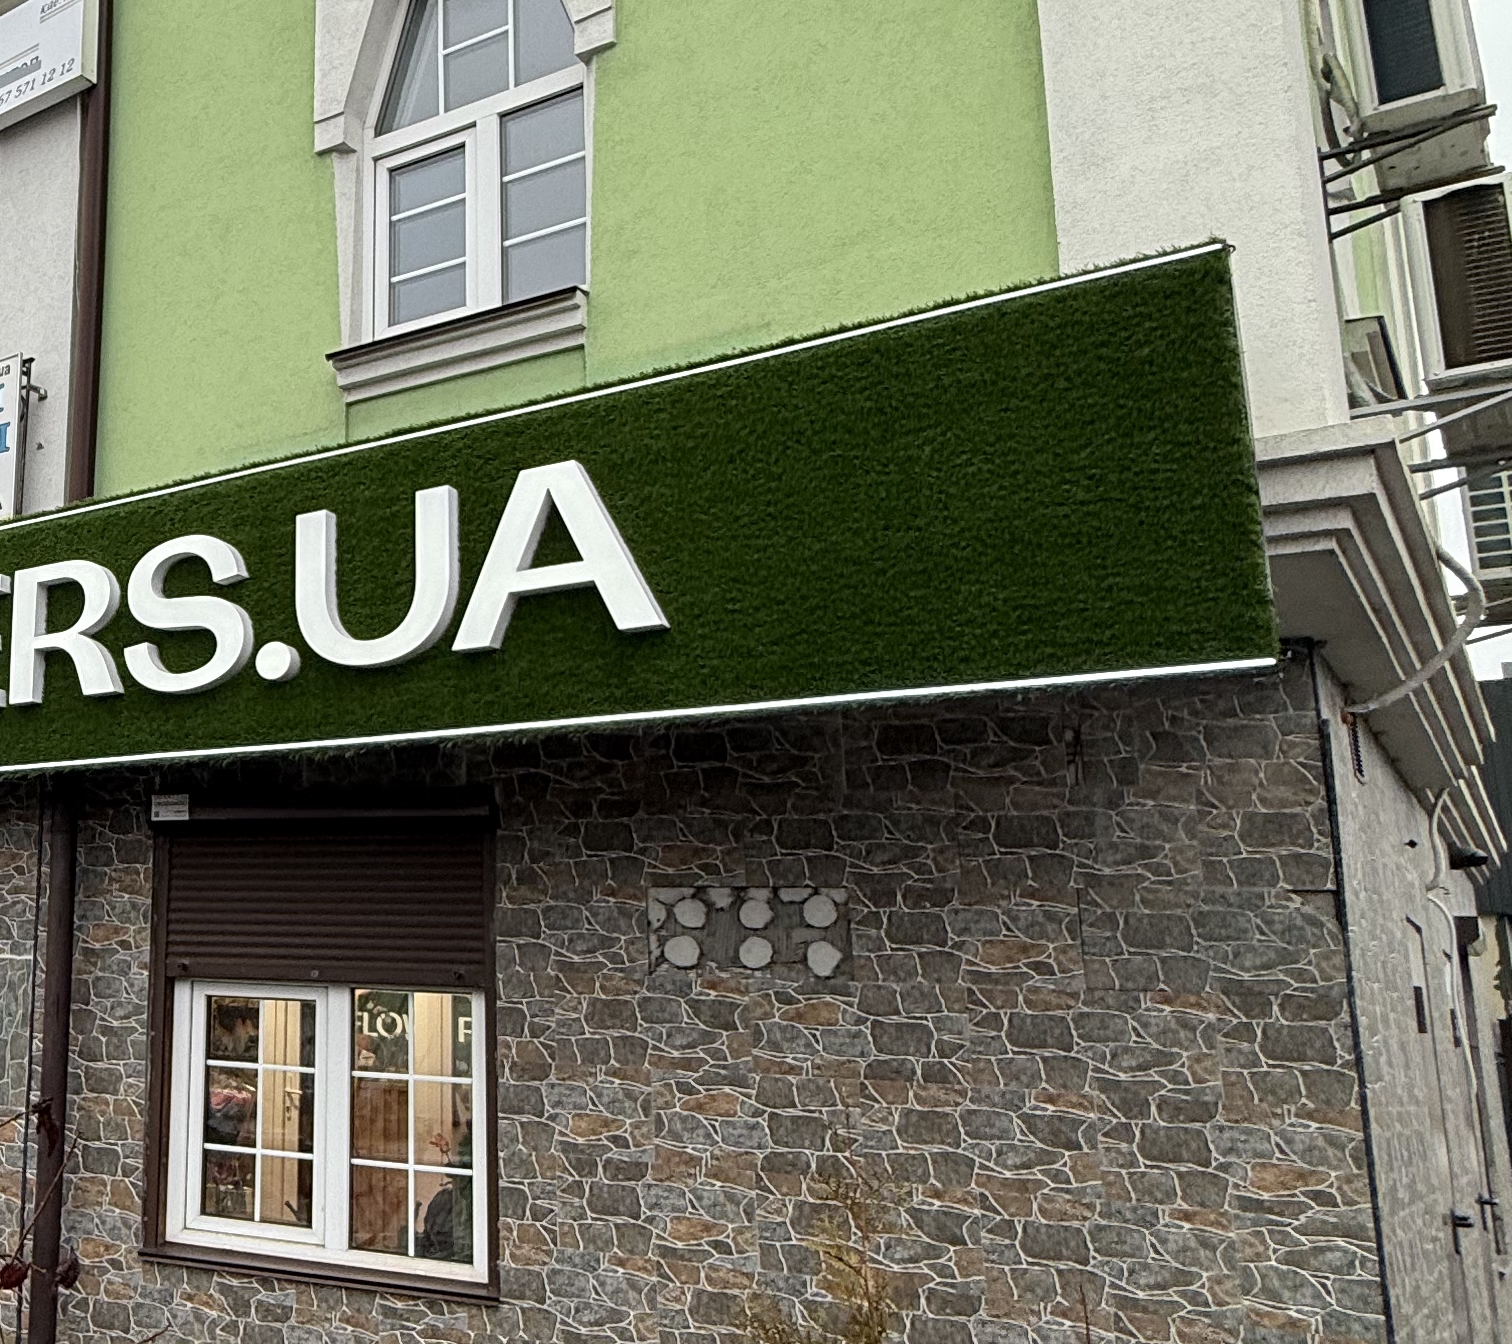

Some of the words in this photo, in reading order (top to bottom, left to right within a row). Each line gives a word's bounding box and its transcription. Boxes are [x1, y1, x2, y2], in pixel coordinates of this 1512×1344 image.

[14, 77, 36, 99] 571
[40, 67, 56, 87] 12
[59, 57, 75, 77] 12
